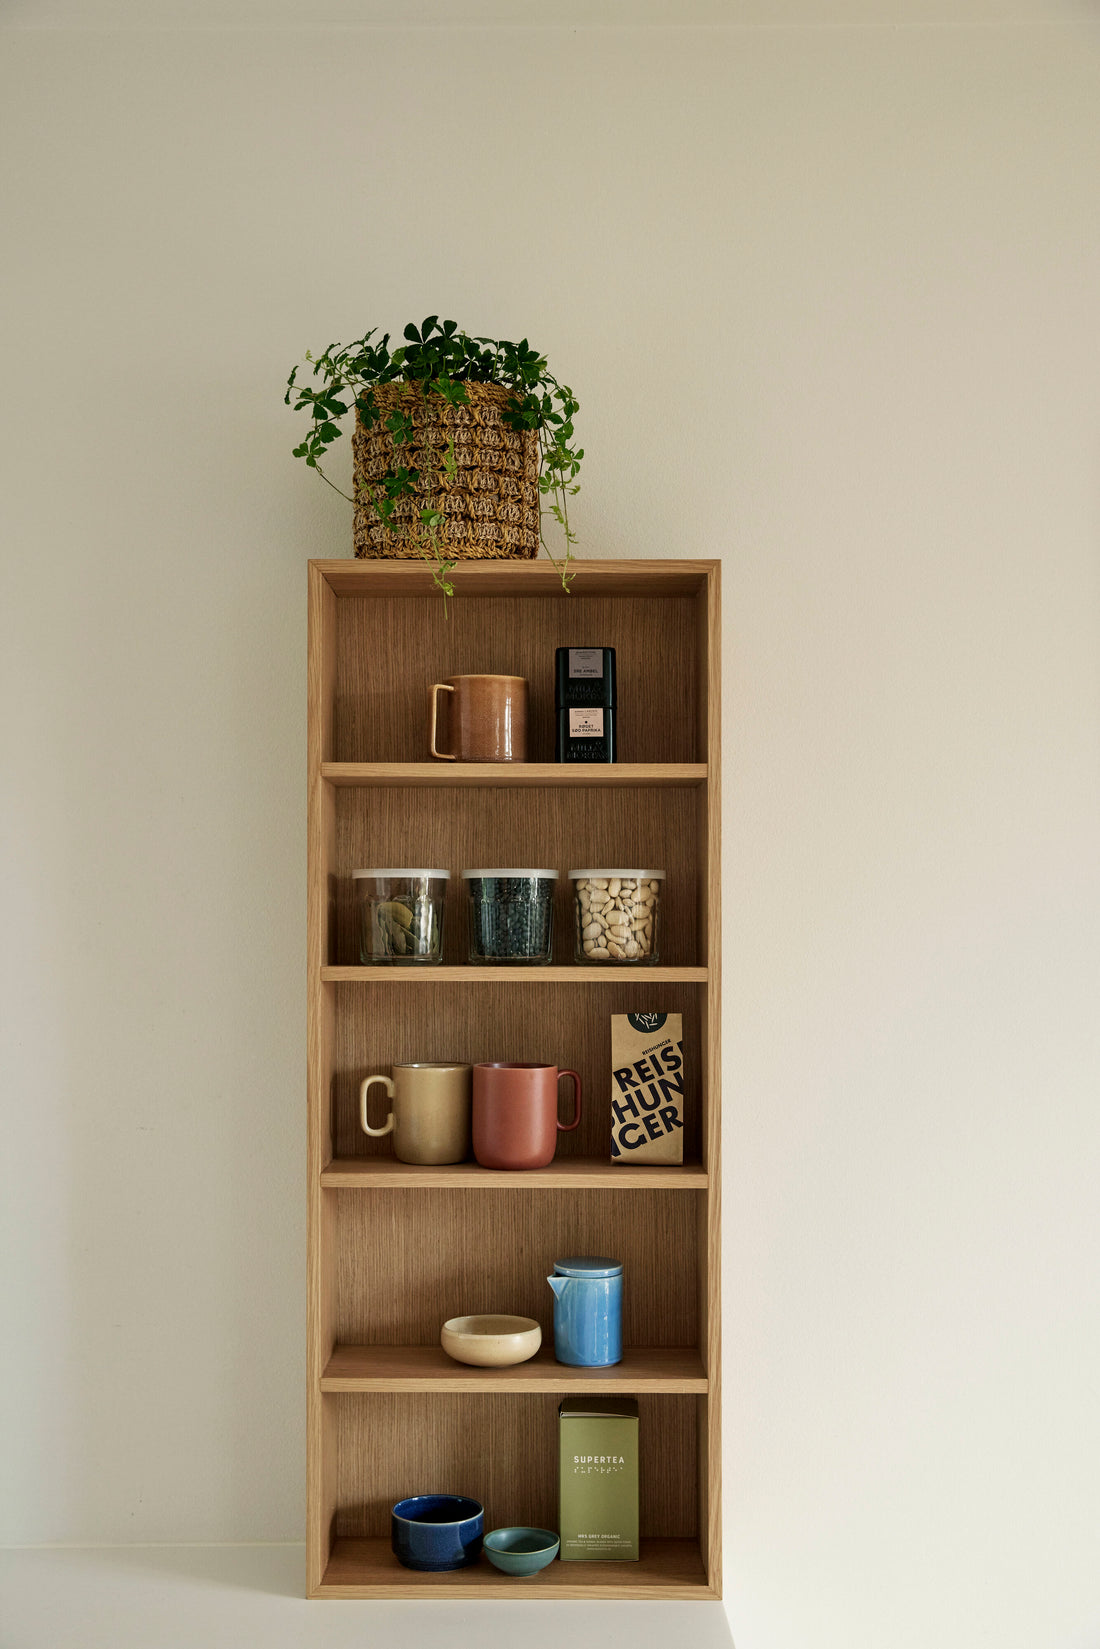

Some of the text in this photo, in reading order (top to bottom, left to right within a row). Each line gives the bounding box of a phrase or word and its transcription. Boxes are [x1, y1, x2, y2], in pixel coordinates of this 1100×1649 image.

[642, 1039, 671, 1056] REISHUNGER
[611, 1071, 683, 1131] HUN
[574, 1455, 625, 1464] SUPERTEA
